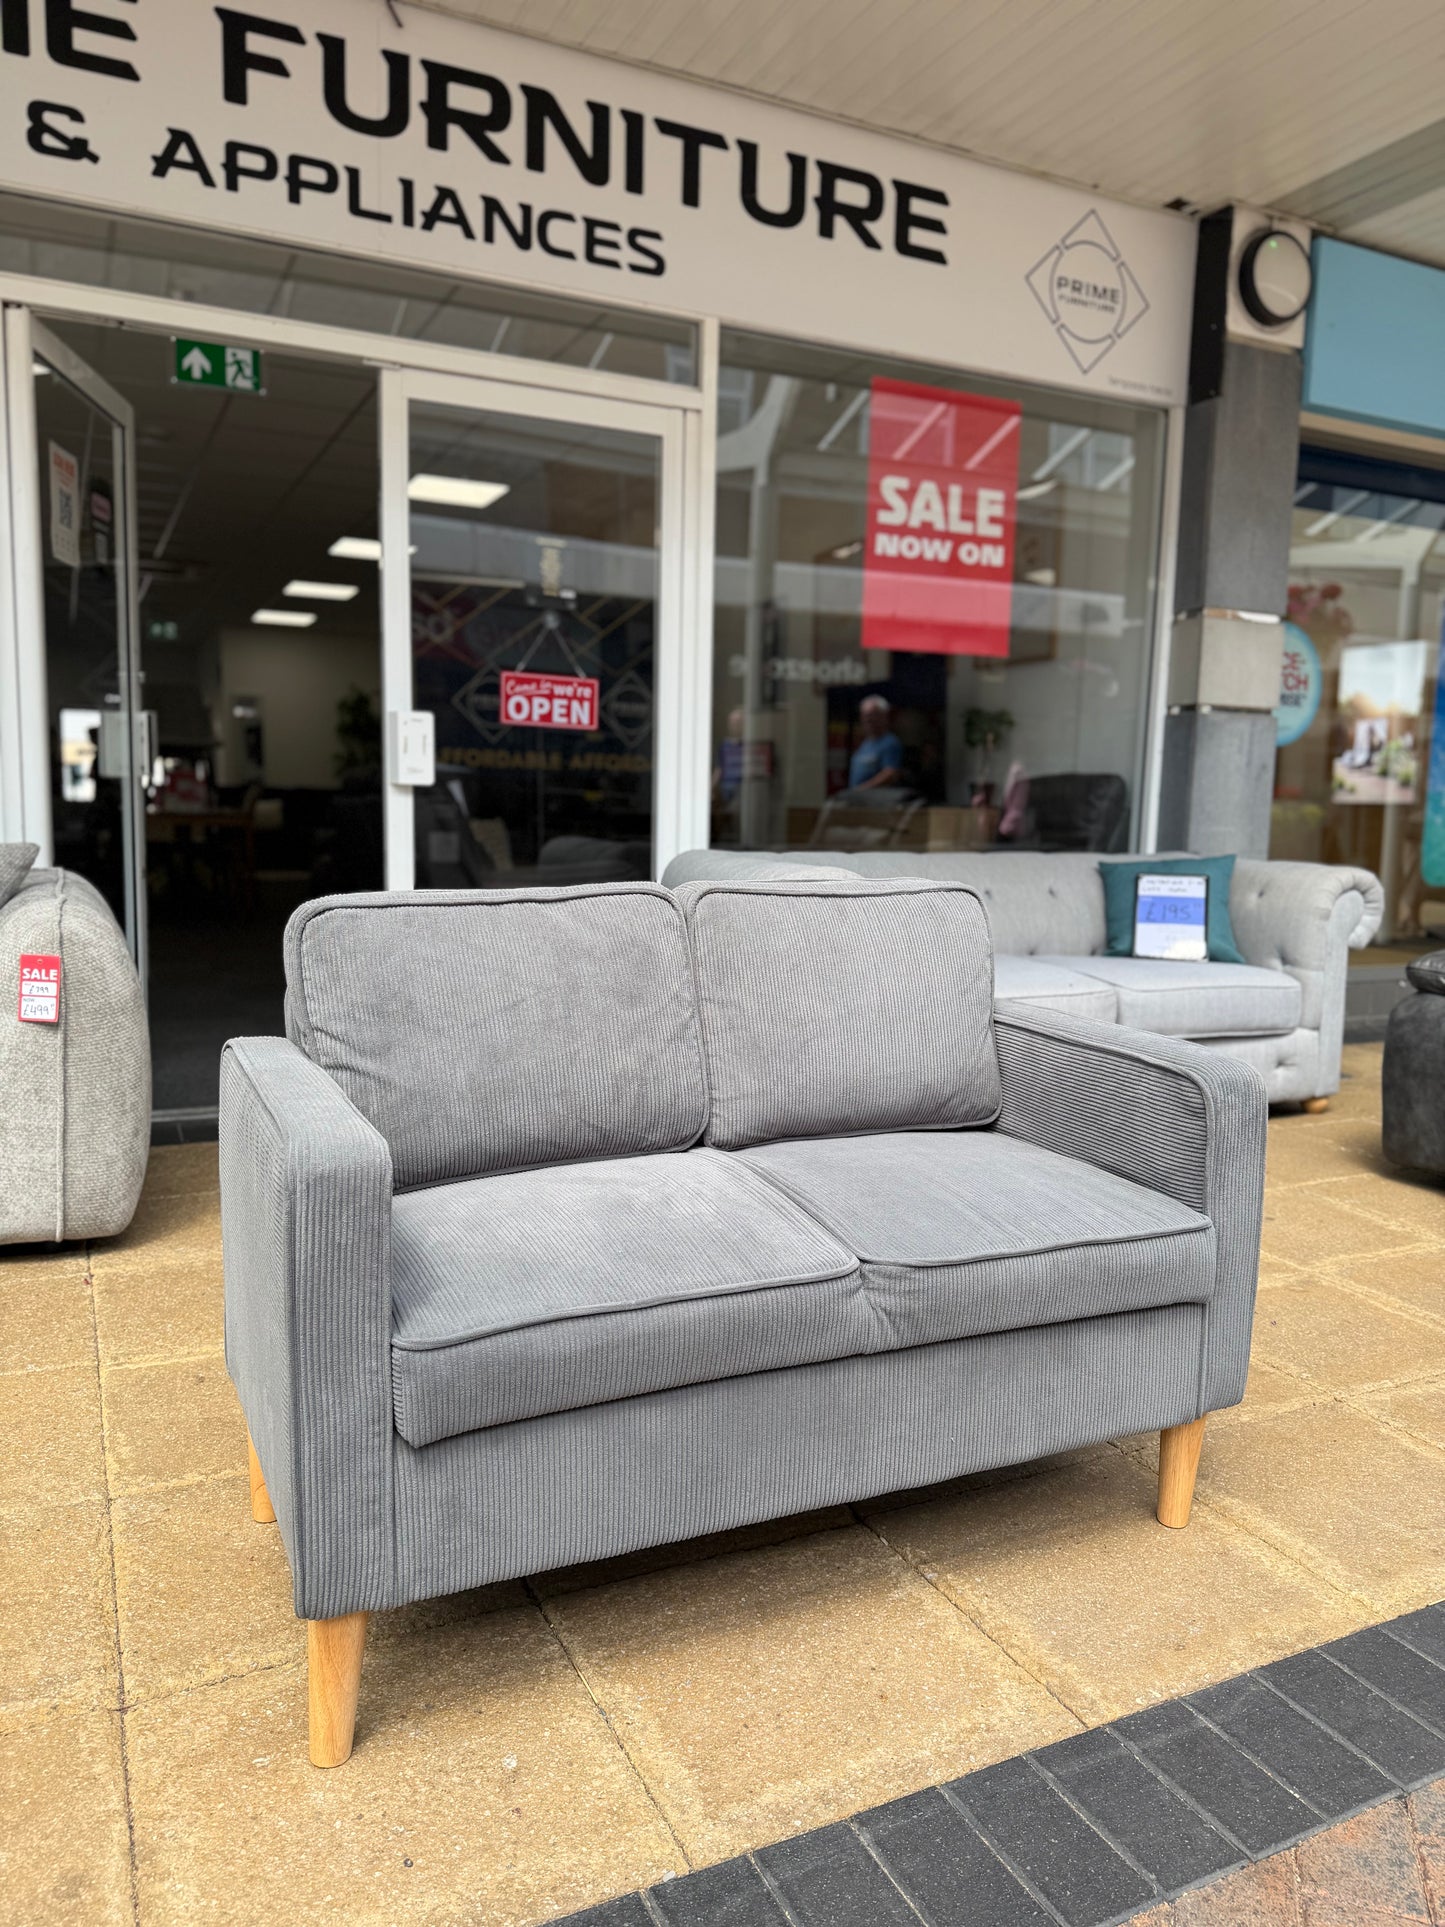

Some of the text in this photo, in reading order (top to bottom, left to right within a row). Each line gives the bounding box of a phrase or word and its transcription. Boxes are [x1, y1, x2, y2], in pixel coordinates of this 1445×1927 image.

[214, 5, 949, 266] FURNITURE
[26, 99, 666, 277] & APPLIANCES
[1056, 275, 1121, 305] PRIME
[876, 474, 1006, 538] SALE
[874, 532, 1005, 568] NOW ON
[552, 681, 592, 699] we're
[506, 694, 591, 726] OPEN
[22, 968, 58, 980] SALE
